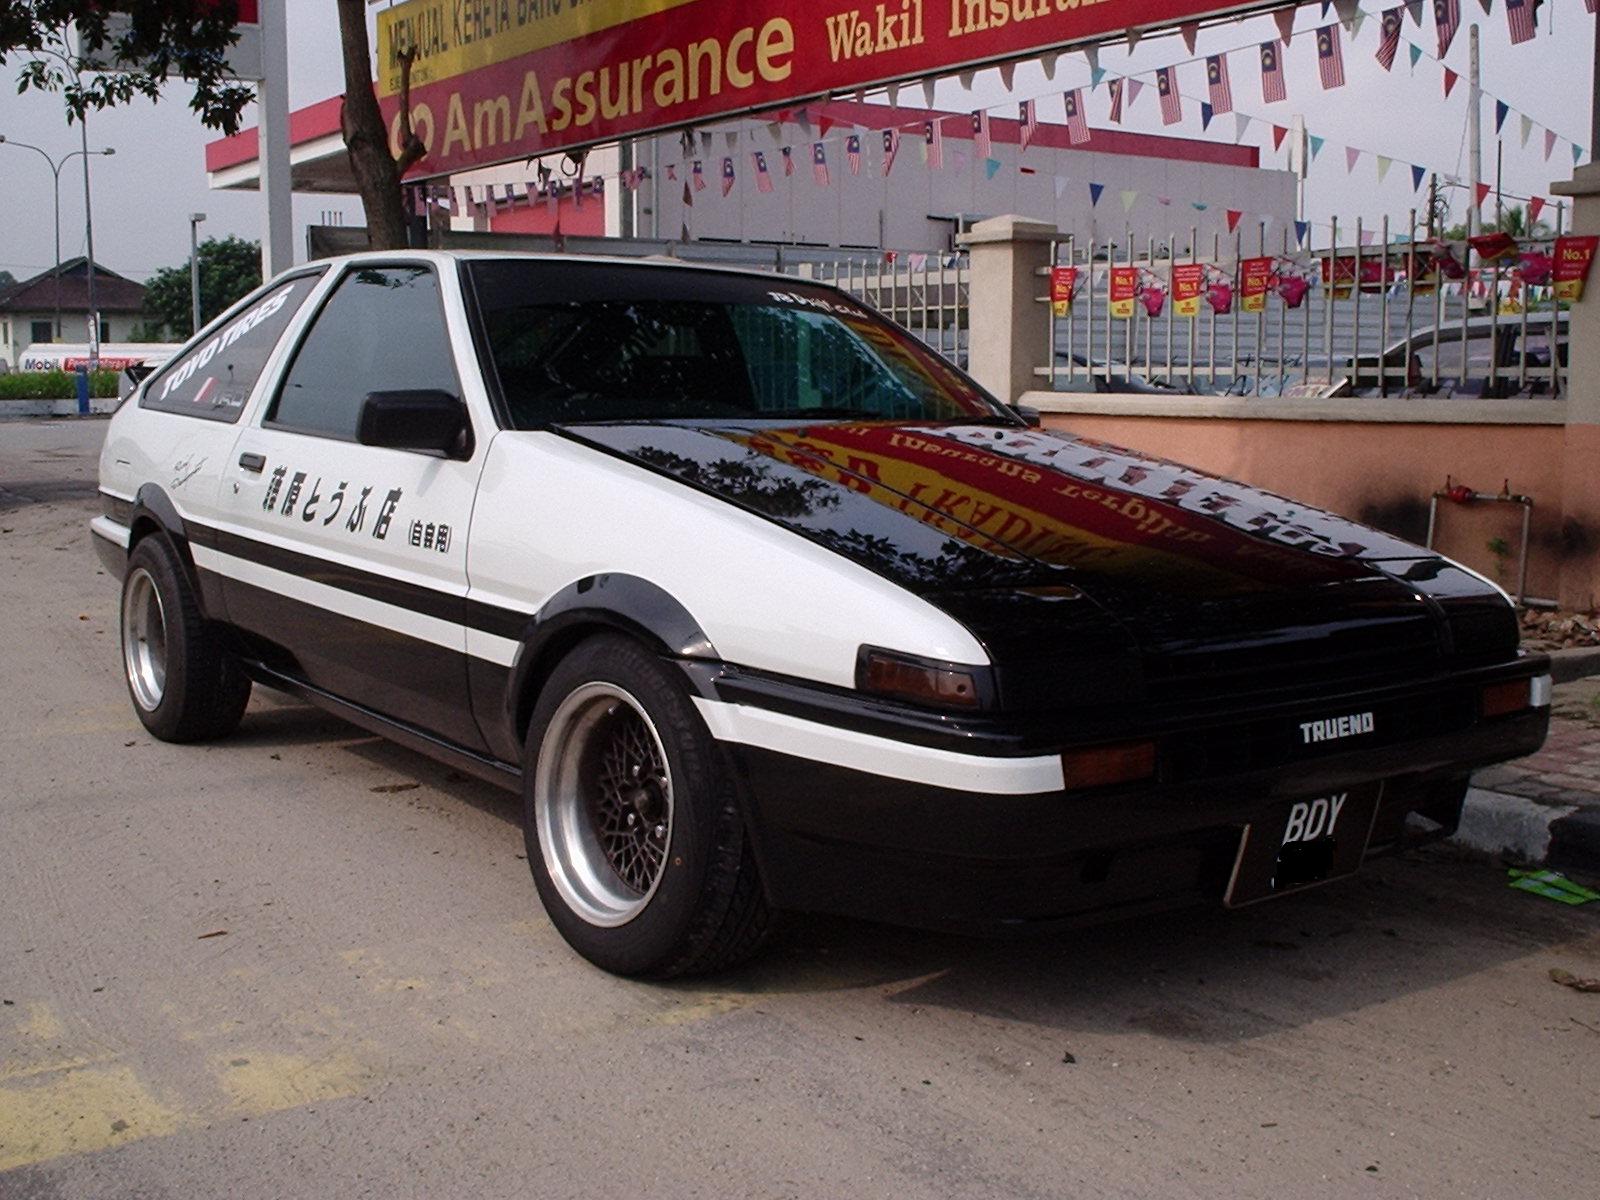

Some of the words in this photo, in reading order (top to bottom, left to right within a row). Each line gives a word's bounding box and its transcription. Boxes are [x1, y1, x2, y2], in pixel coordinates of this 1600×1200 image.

[825, 0, 925, 62] Wakil
[442, 16, 795, 157] AmAssurance
[24, 358, 60, 370] Mobil
[160, 337, 220, 401] TOYO
[1299, 711, 1375, 744] TRUENO
[1281, 792, 1348, 846] BDY
